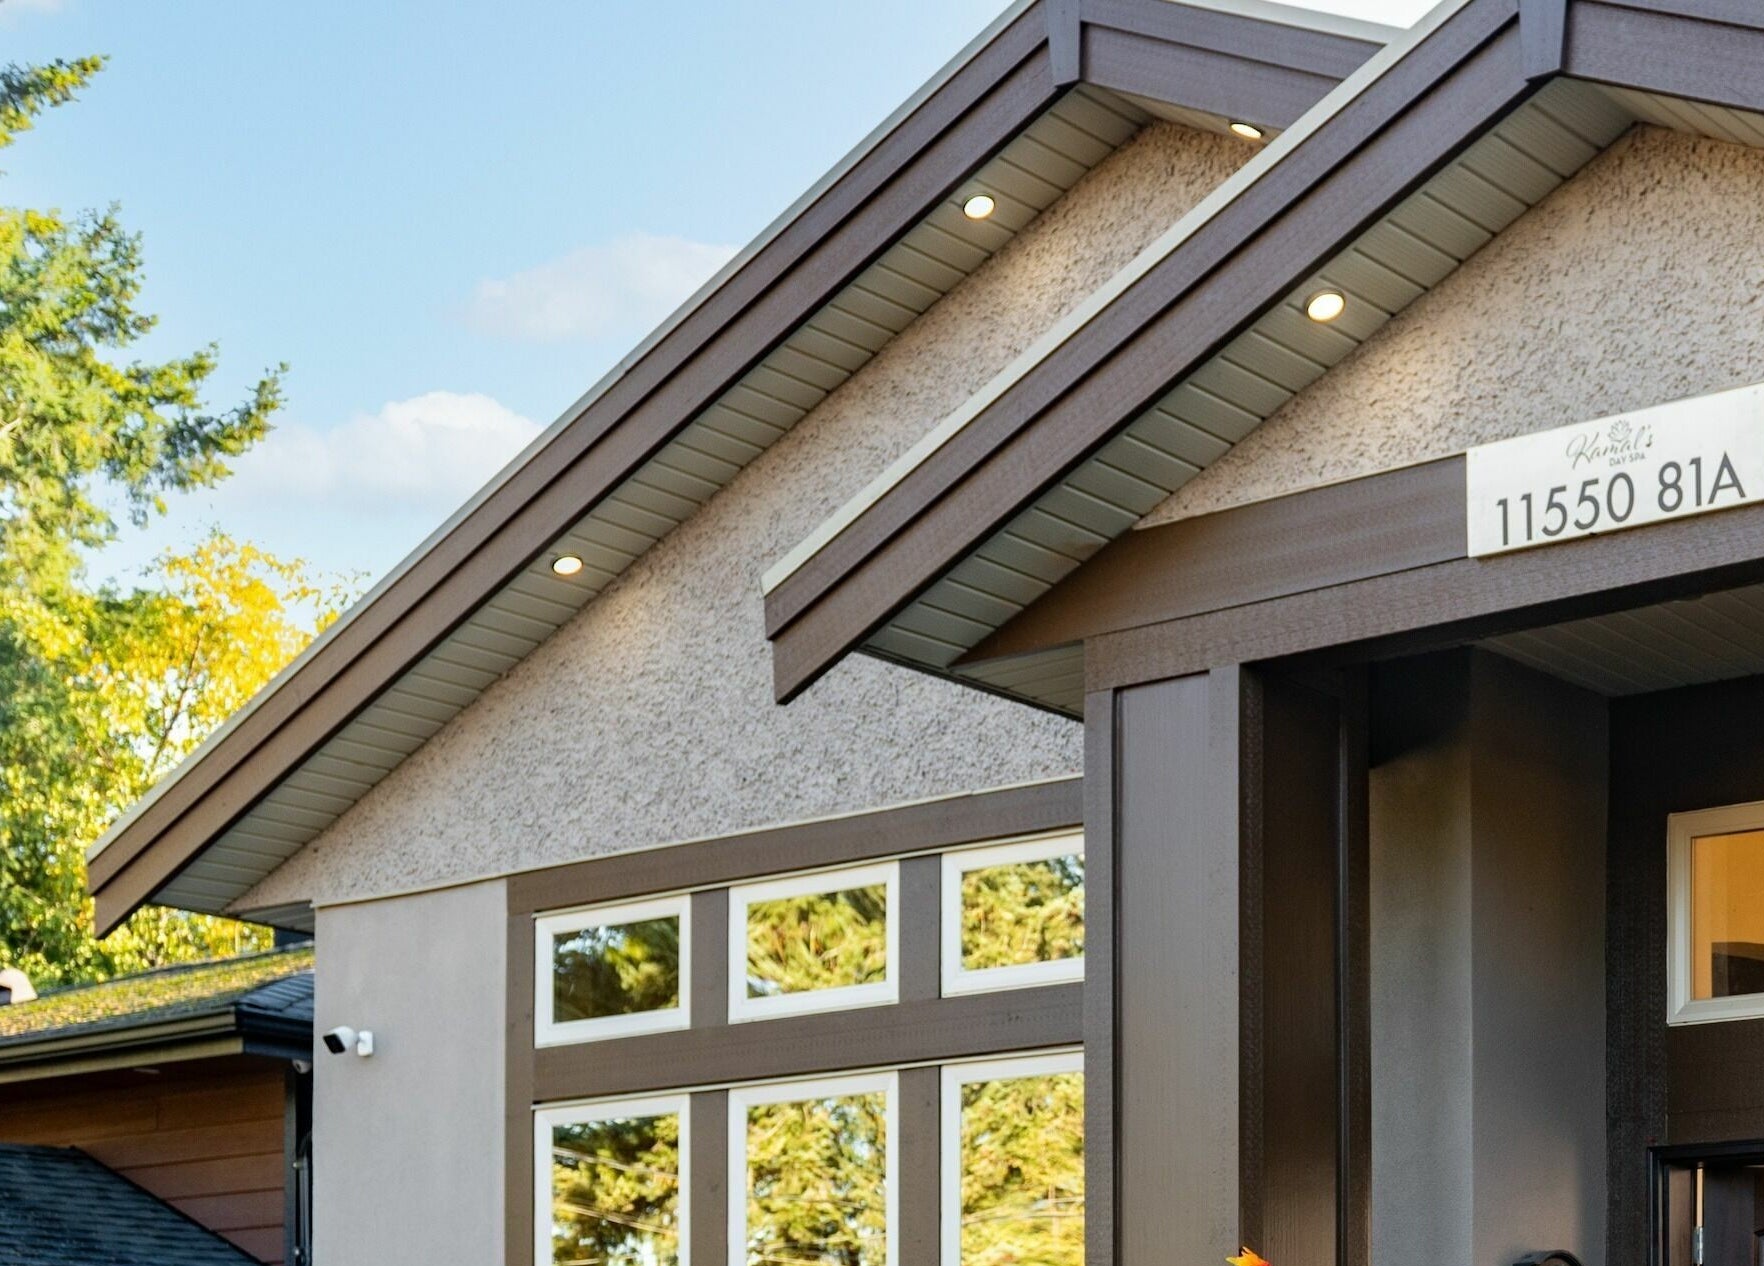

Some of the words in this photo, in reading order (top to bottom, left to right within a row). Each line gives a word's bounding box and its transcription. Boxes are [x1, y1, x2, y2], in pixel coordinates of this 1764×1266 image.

[1566, 424, 1653, 470] Kamal's
[1609, 456, 1627, 467] DAY
[1629, 452, 1645, 463] SPA
[1496, 472, 1635, 546] 11550
[1657, 452, 1746, 512] 81A
